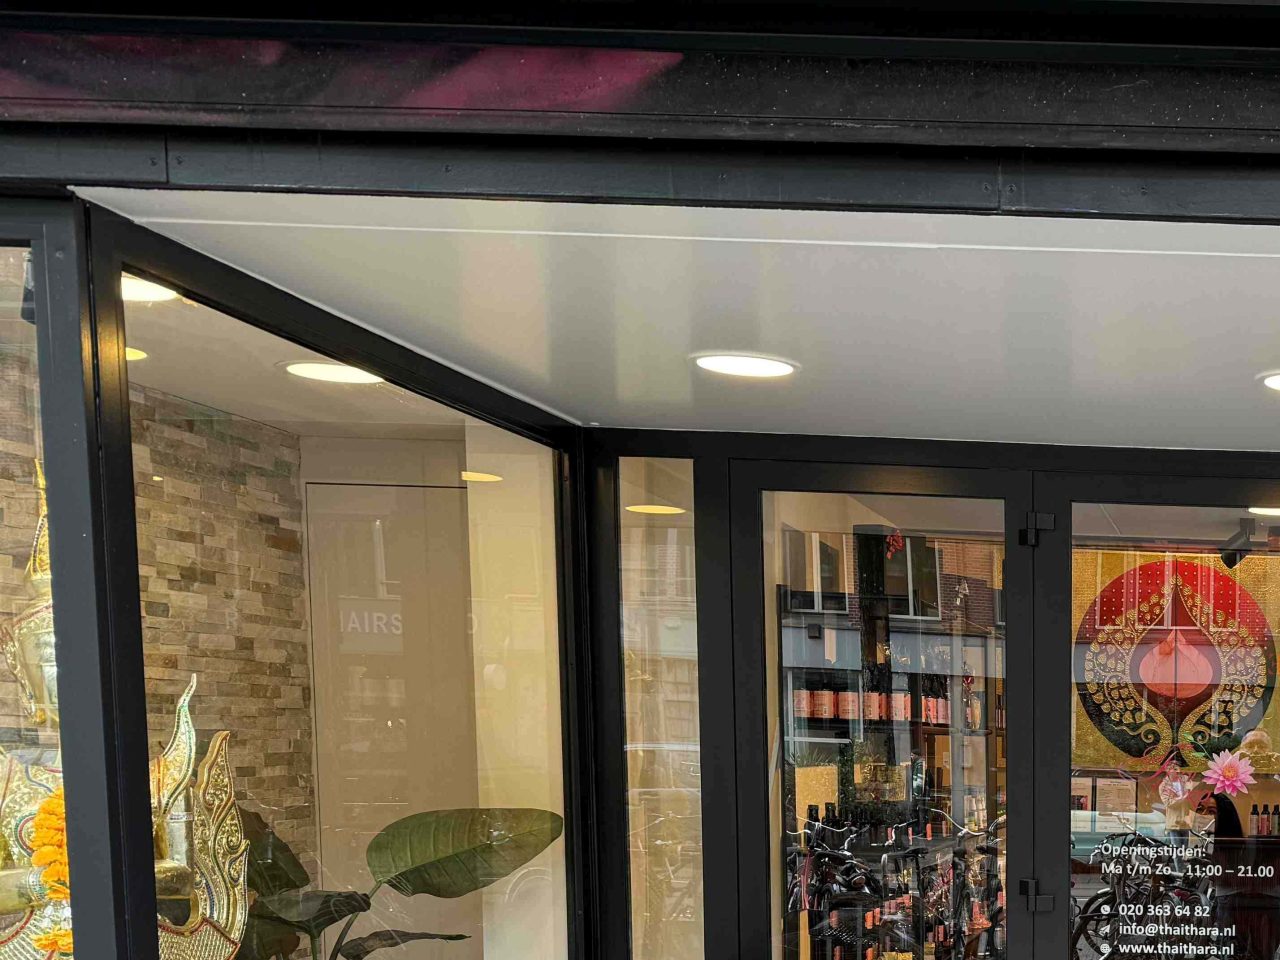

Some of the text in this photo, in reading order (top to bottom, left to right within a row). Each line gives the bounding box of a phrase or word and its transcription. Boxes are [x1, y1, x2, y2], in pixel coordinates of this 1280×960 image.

[1101, 844, 1206, 858] Openingstijden:
[1101, 862, 1122, 874] Ma
[1126, 862, 1151, 875] t/m
[1155, 864, 1172, 875] Zo
[1237, 865, 1274, 877] 21.00
[1119, 904, 1210, 917] 020 363 64 82
[1119, 923, 1236, 937] info@thaithara.nl
[1119, 942, 1234, 955] www.thaithara.nl
